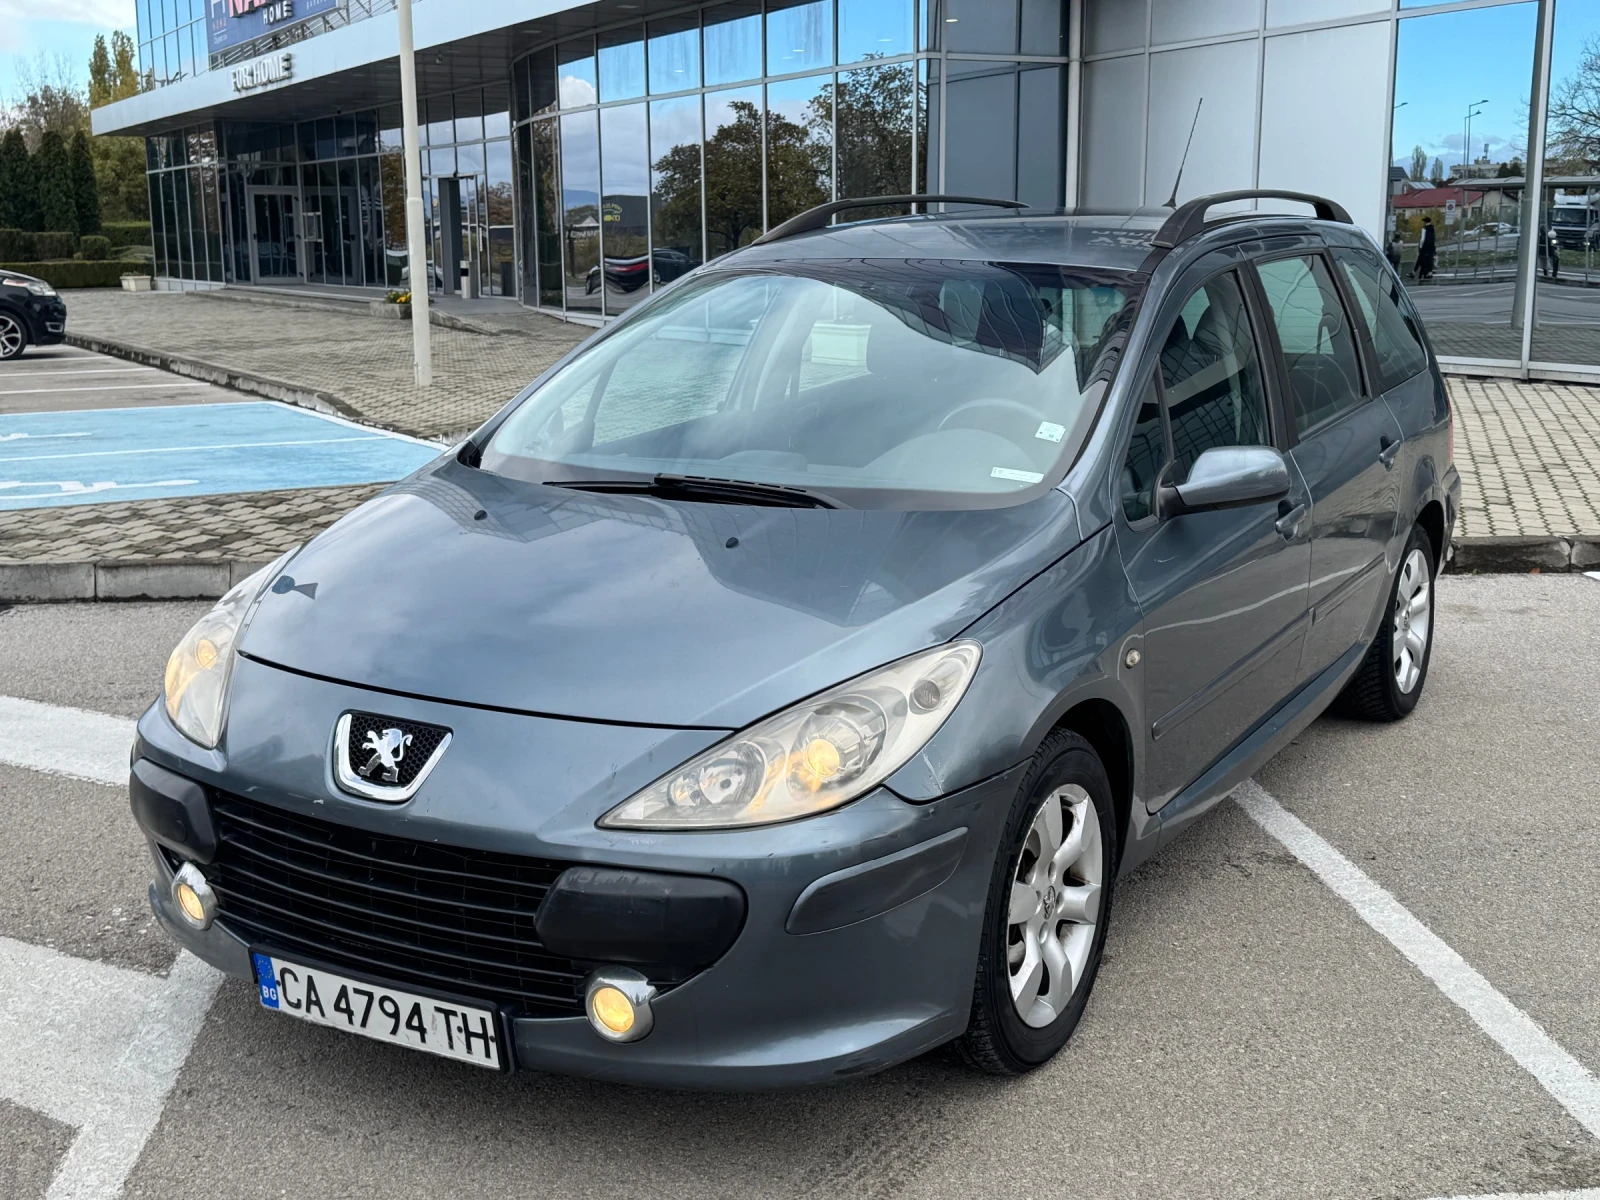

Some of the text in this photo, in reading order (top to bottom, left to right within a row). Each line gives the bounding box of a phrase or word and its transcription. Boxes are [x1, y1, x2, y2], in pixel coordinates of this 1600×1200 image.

[263, 0, 292, 25] HOME
[231, 53, 293, 92] FOR HOME
[262, 984, 278, 1001] BG
[279, 966, 491, 1059] CA 4794 TH
